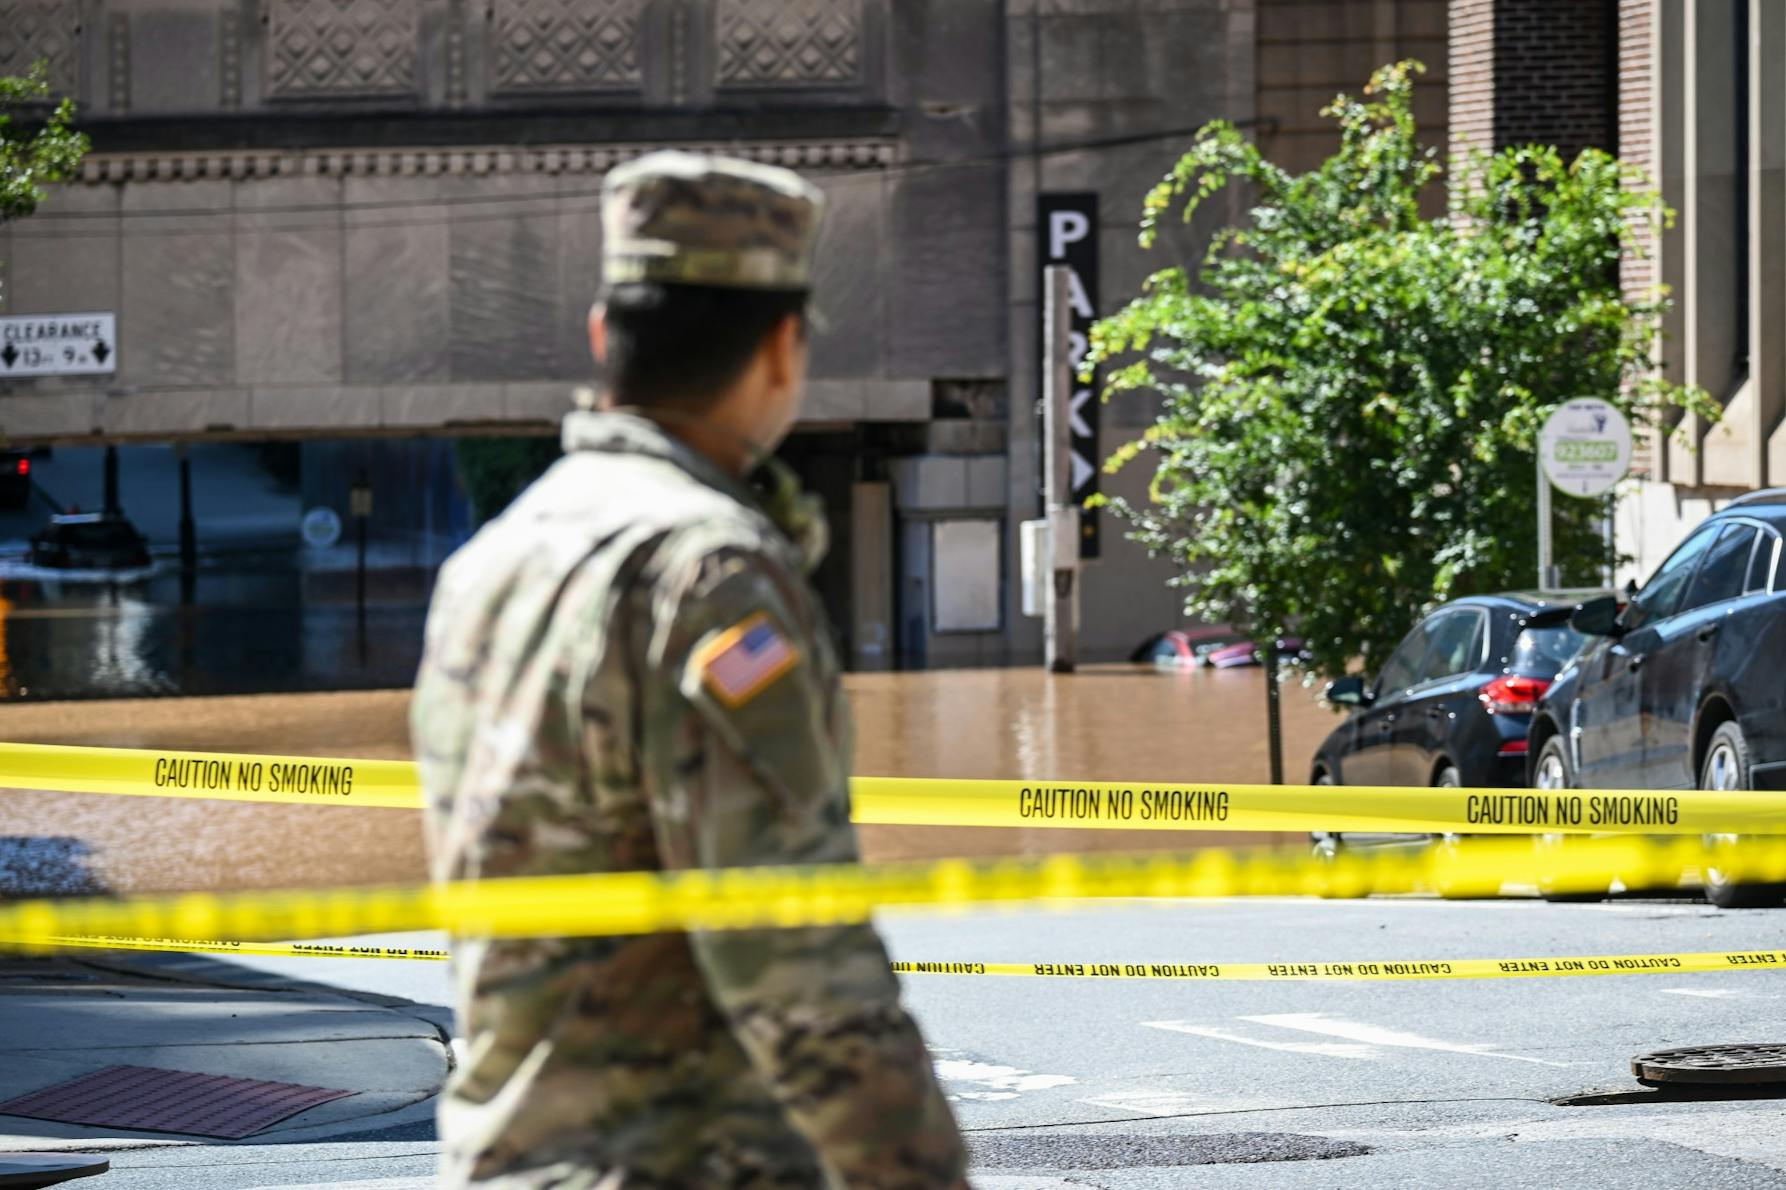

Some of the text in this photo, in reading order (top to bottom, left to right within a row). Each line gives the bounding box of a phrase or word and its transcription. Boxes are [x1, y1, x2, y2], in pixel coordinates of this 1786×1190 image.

[4, 321, 101, 342] CLEARANCE
[155, 758, 353, 795] CAUTION NO SMOKING
[1020, 788, 1229, 821] CAUTION NO SMOKING
[1467, 795, 1679, 825] CAUTION NO SMOKING
[1498, 957, 1681, 972] CAUTION DO NOT ENTER
[1726, 954, 1777, 964] ENTER
[1034, 963, 1220, 977] CAUTION DO NOT ENTER
[1267, 963, 1452, 976] CAUTION DO NOT ENTER
